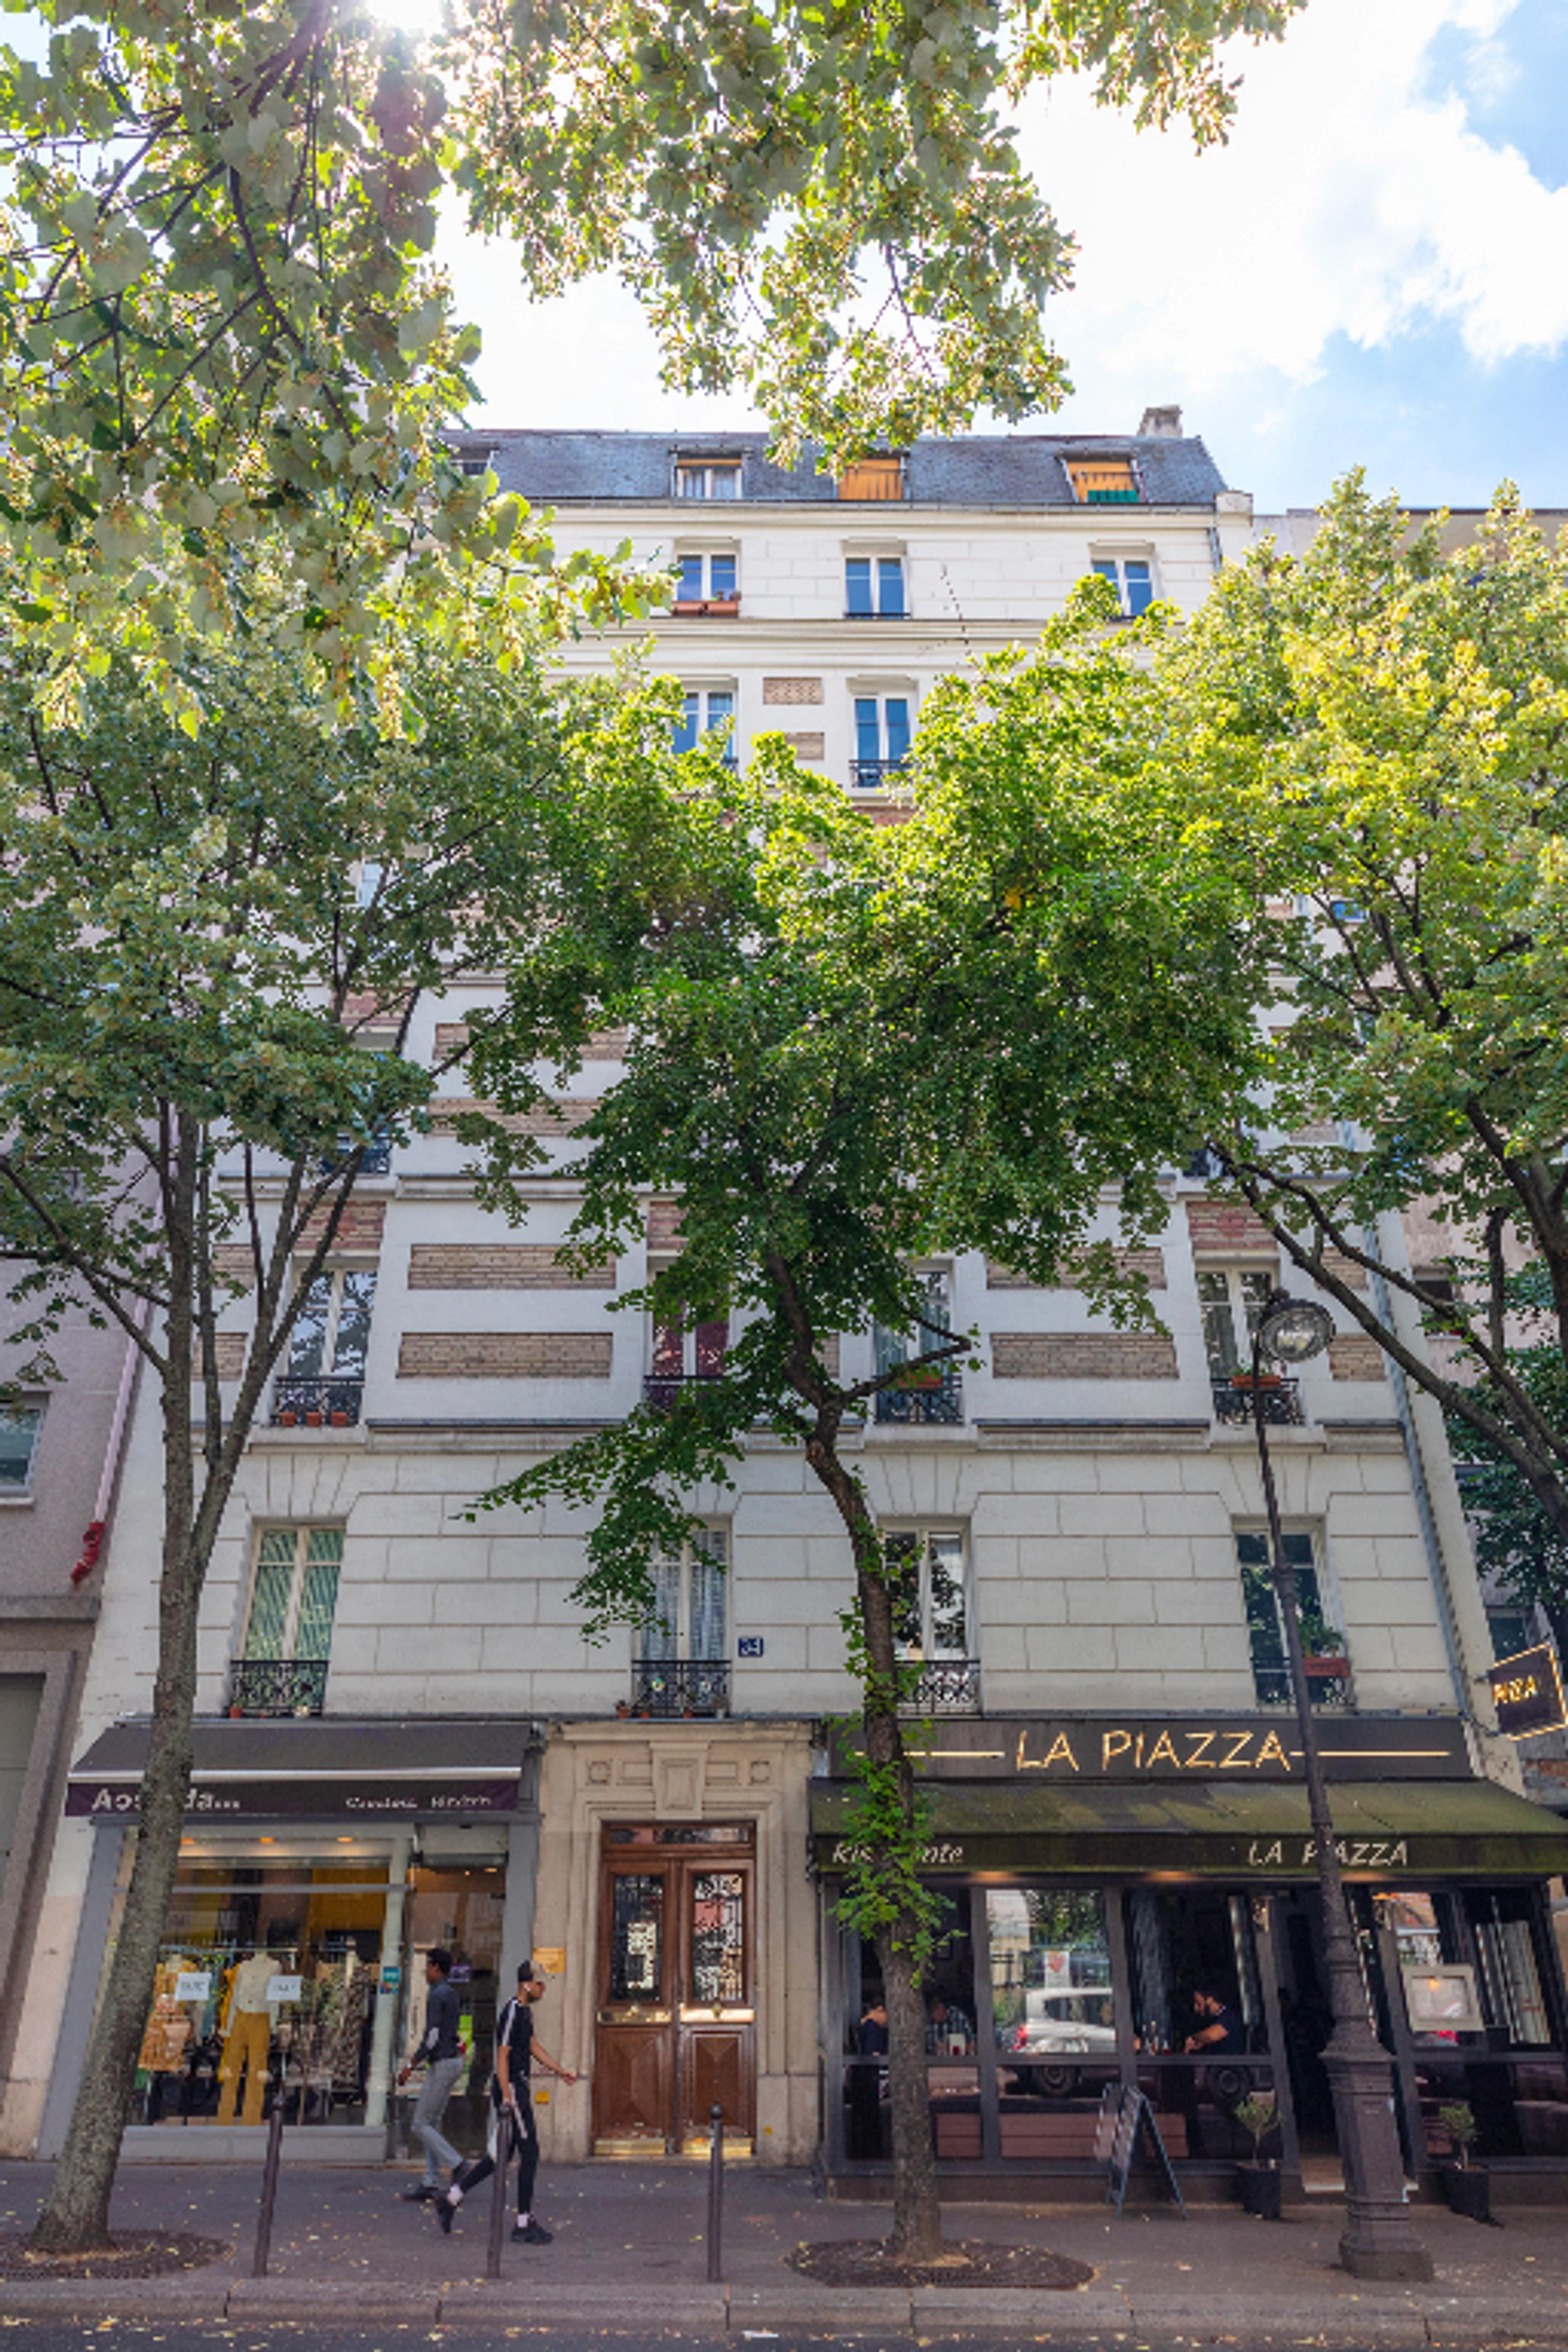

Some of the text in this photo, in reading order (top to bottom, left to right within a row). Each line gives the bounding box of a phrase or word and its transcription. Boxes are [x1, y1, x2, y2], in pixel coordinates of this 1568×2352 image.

[1017, 1730, 1291, 1771] LA PIAZZA
[1249, 1840, 1408, 1867] LA PAZZA
